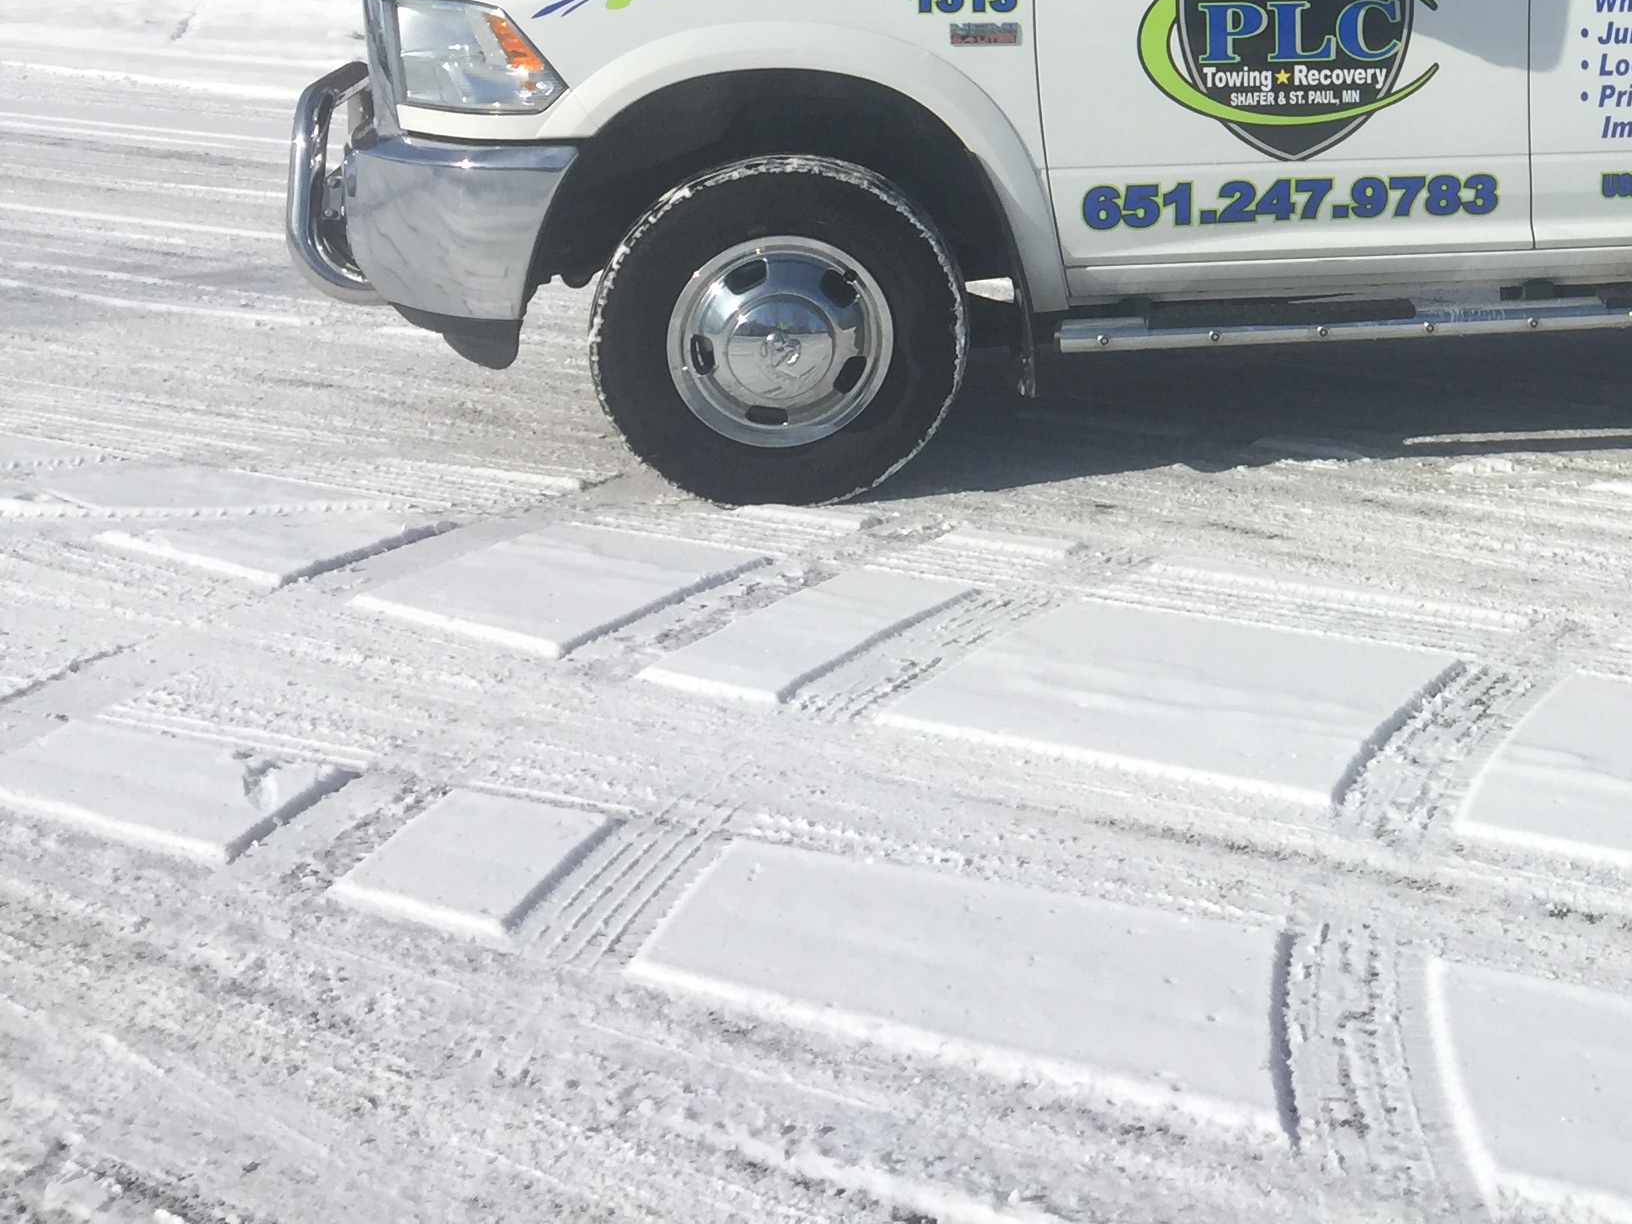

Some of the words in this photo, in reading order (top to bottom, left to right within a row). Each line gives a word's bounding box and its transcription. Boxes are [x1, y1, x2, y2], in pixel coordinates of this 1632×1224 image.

[1202, 66, 1272, 91] Towing
[1293, 64, 1387, 89] Recovery
[1230, 91, 1275, 106] SHAFER
[1277, 90, 1287, 105] &
[1289, 90, 1306, 106] ST.
[1308, 89, 1340, 106] PAUL,
[1342, 89, 1360, 104] MN
[1082, 173, 1499, 230] 651.247.9783
